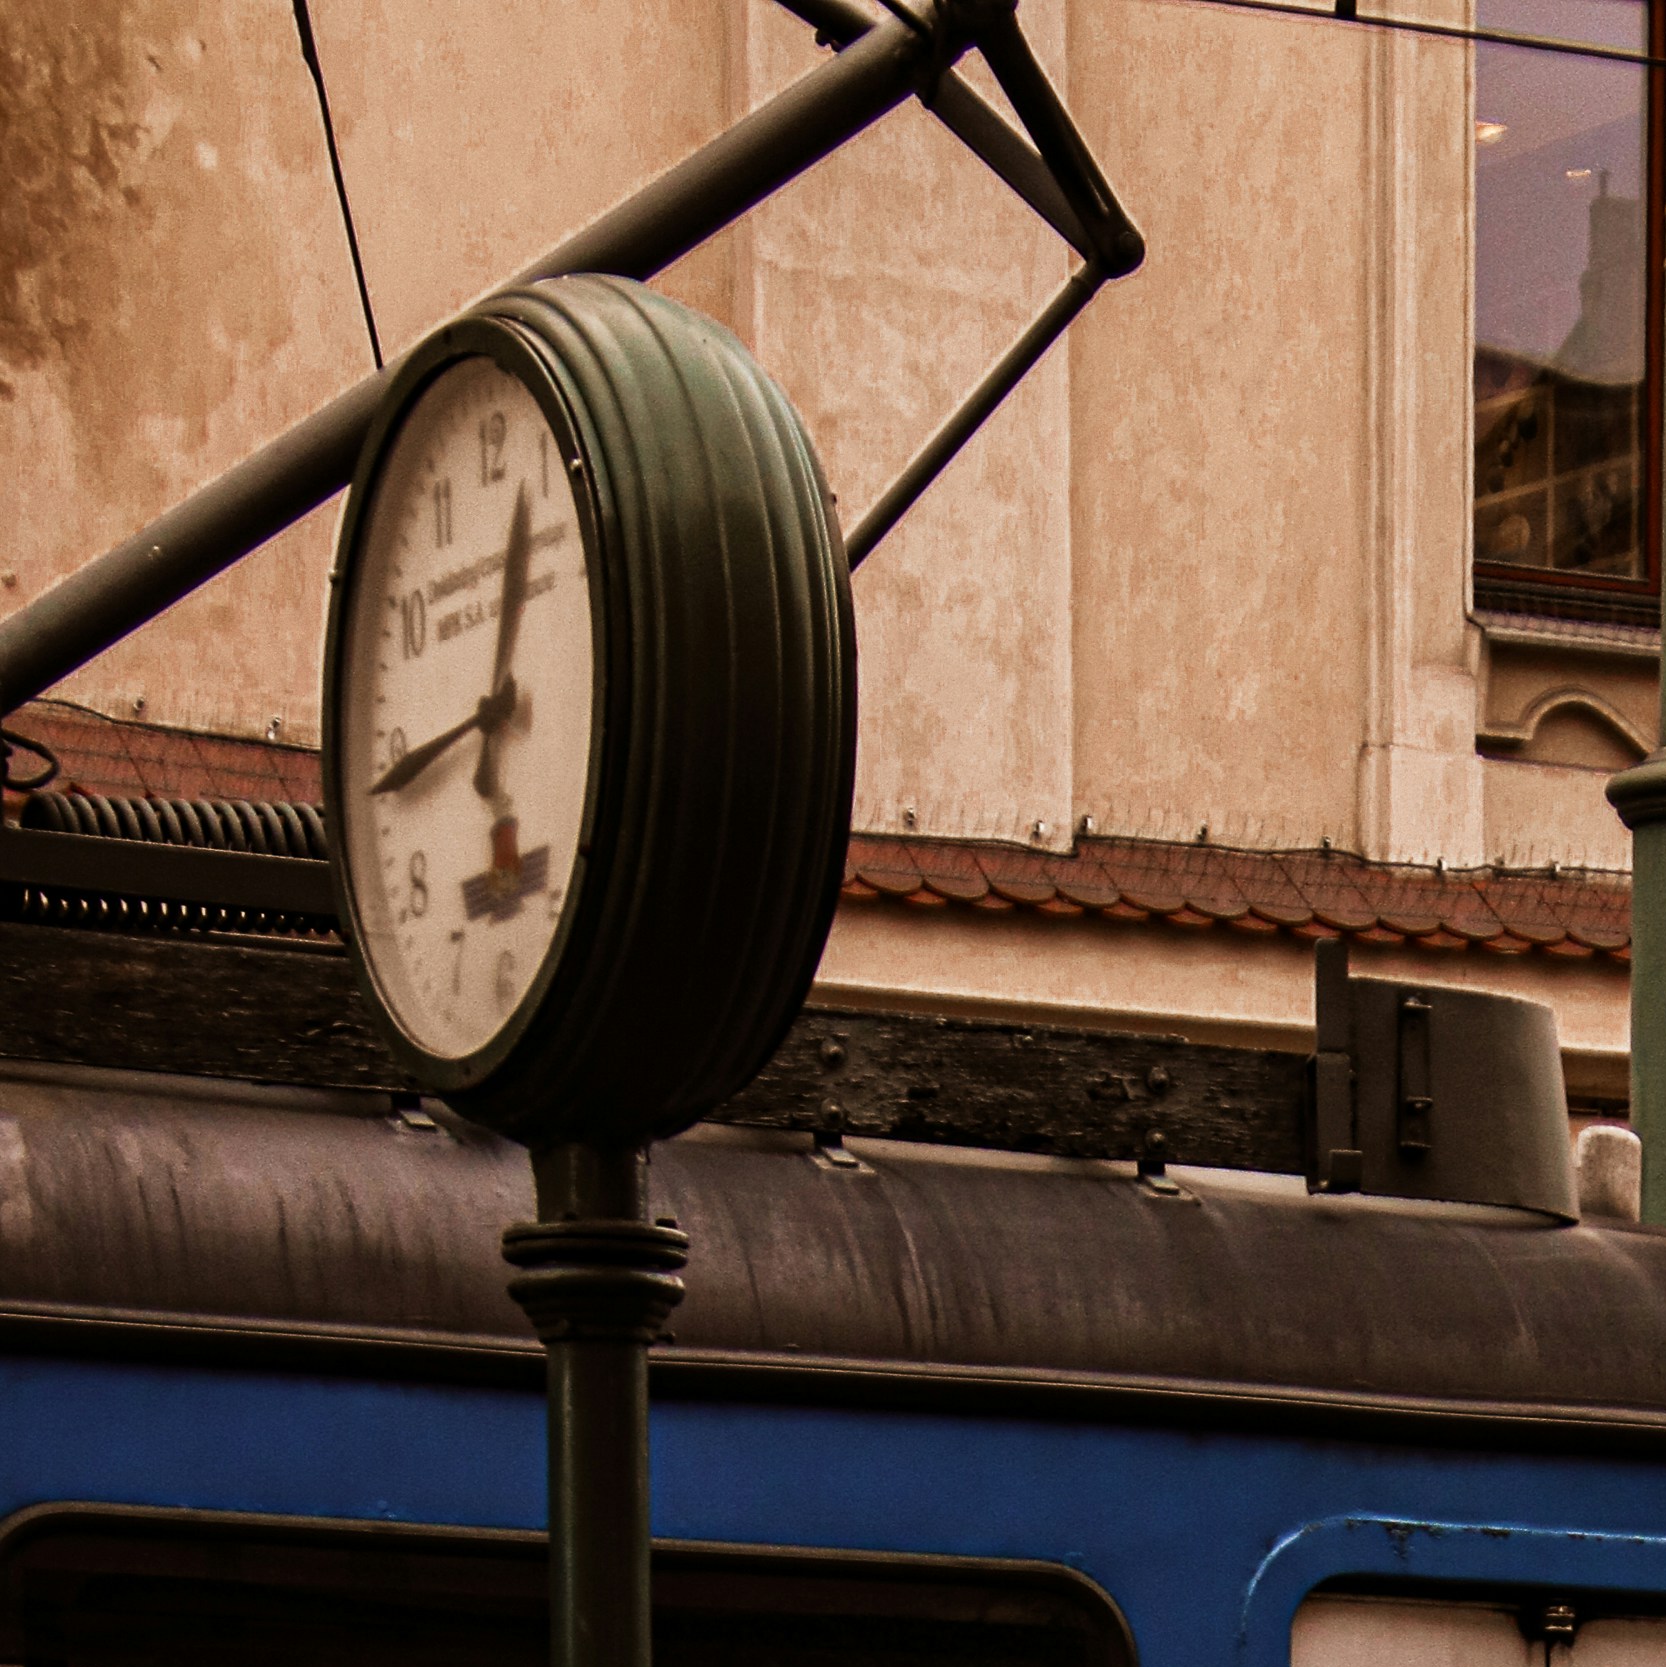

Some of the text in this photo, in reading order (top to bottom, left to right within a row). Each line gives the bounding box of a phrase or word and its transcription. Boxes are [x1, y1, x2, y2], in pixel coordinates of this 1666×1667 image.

[480, 411, 506, 487] 12
[540, 432, 549, 498] 1
[434, 477, 453, 549] 11
[402, 589, 426, 660] 10
[410, 851, 428, 918] 8
[451, 930, 465, 997] 7
